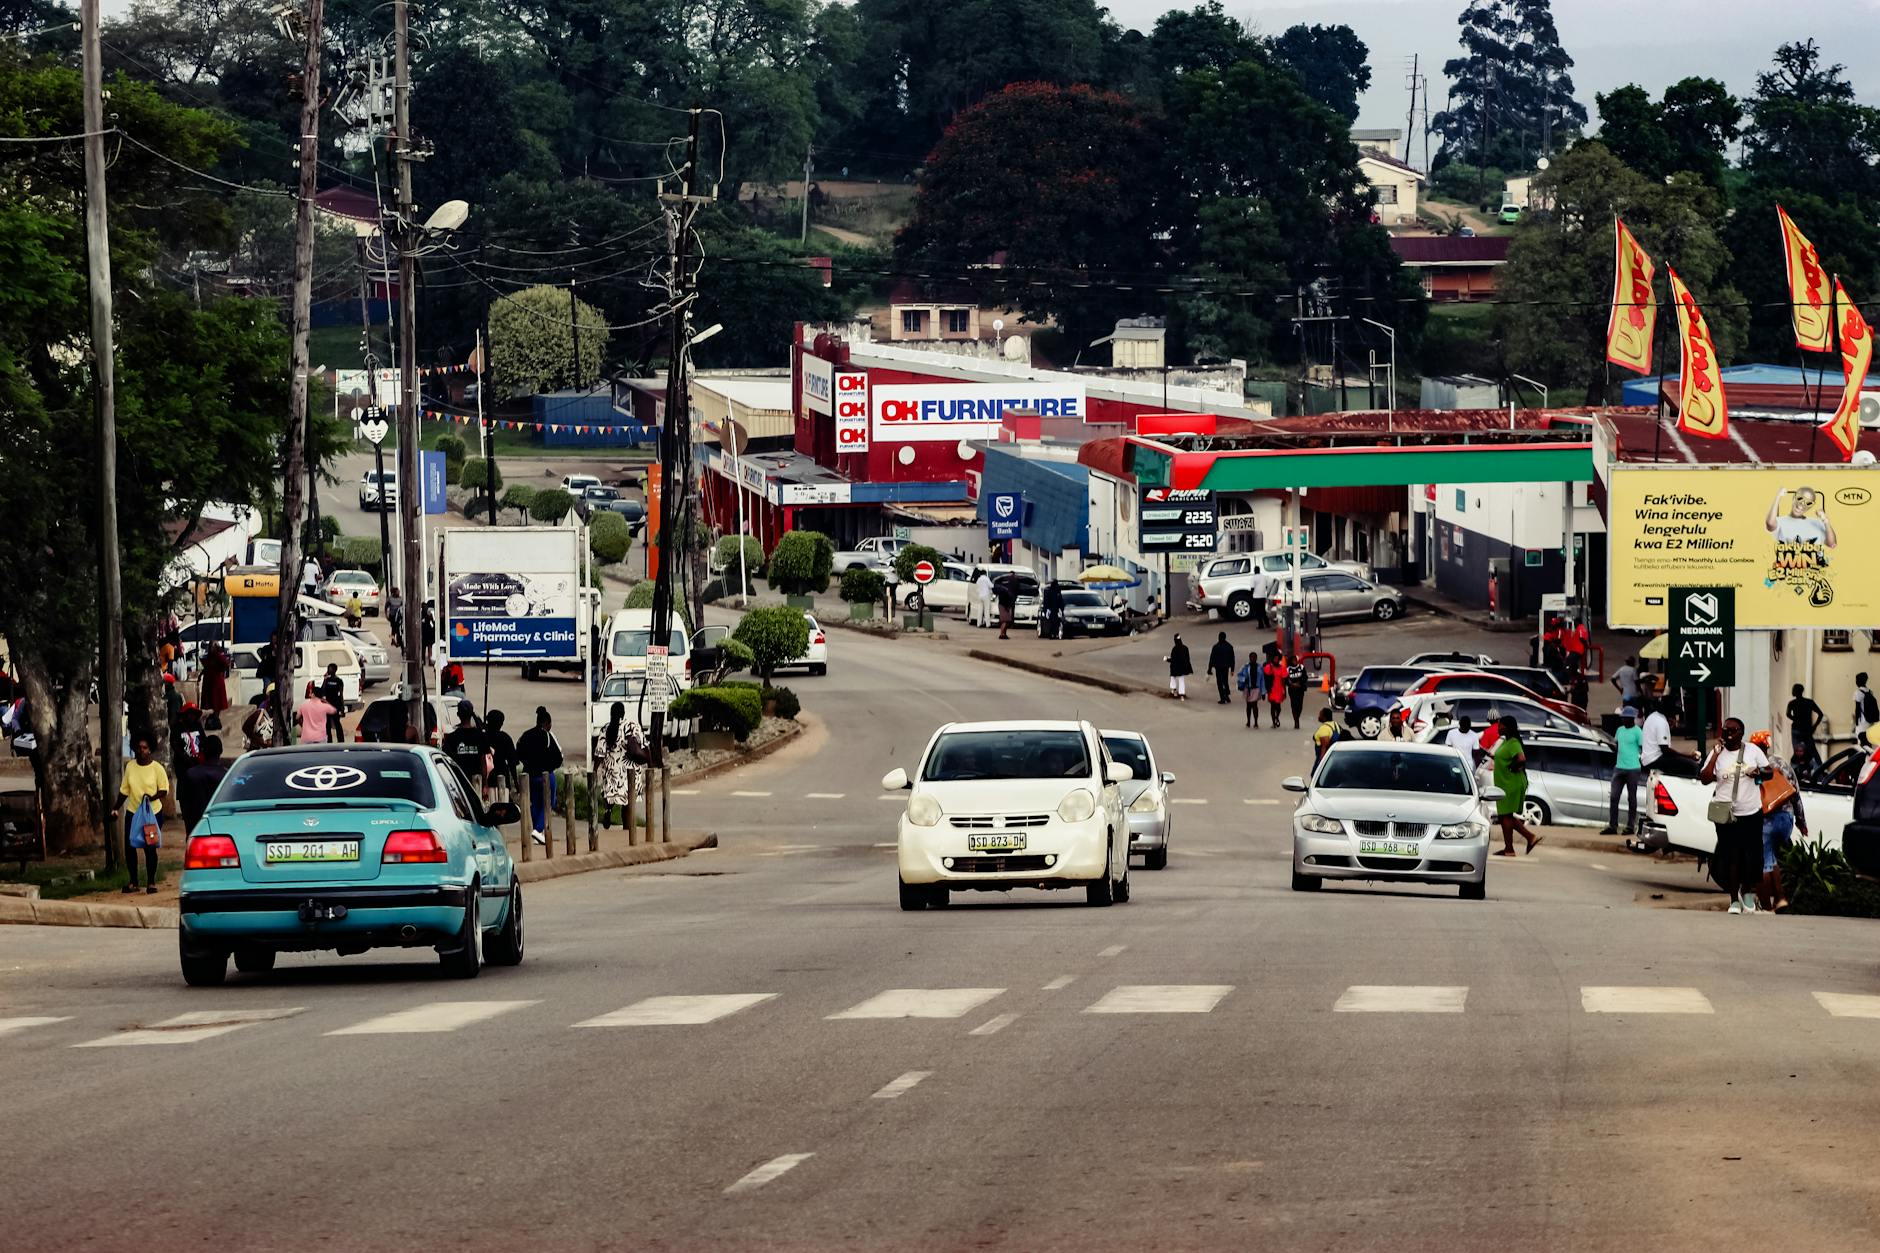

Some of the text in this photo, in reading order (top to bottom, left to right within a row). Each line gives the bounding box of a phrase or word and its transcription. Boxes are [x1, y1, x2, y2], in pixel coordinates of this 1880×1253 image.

[838, 376, 865, 391] OK
[839, 402, 866, 417] OK
[881, 400, 918, 421] OK
[839, 428, 866, 443] OK
[1644, 494, 1707, 506] Fak'ivibe.
[1843, 493, 1863, 501] MTN
[1635, 508, 1723, 522] Wina incenye
[1224, 517, 1255, 530] SWAZI
[1634, 538, 1734, 550] kwa E2 Million!
[473, 622, 516, 632] LifeMed
[1680, 627, 1722, 635] NEDBANK
[473, 631, 575, 644] Pharmacy & Clinic
[1680, 641, 1724, 658] ATM
[991, 836, 1008, 847] 873
[269, 844, 357, 858] SSD 201 AH
